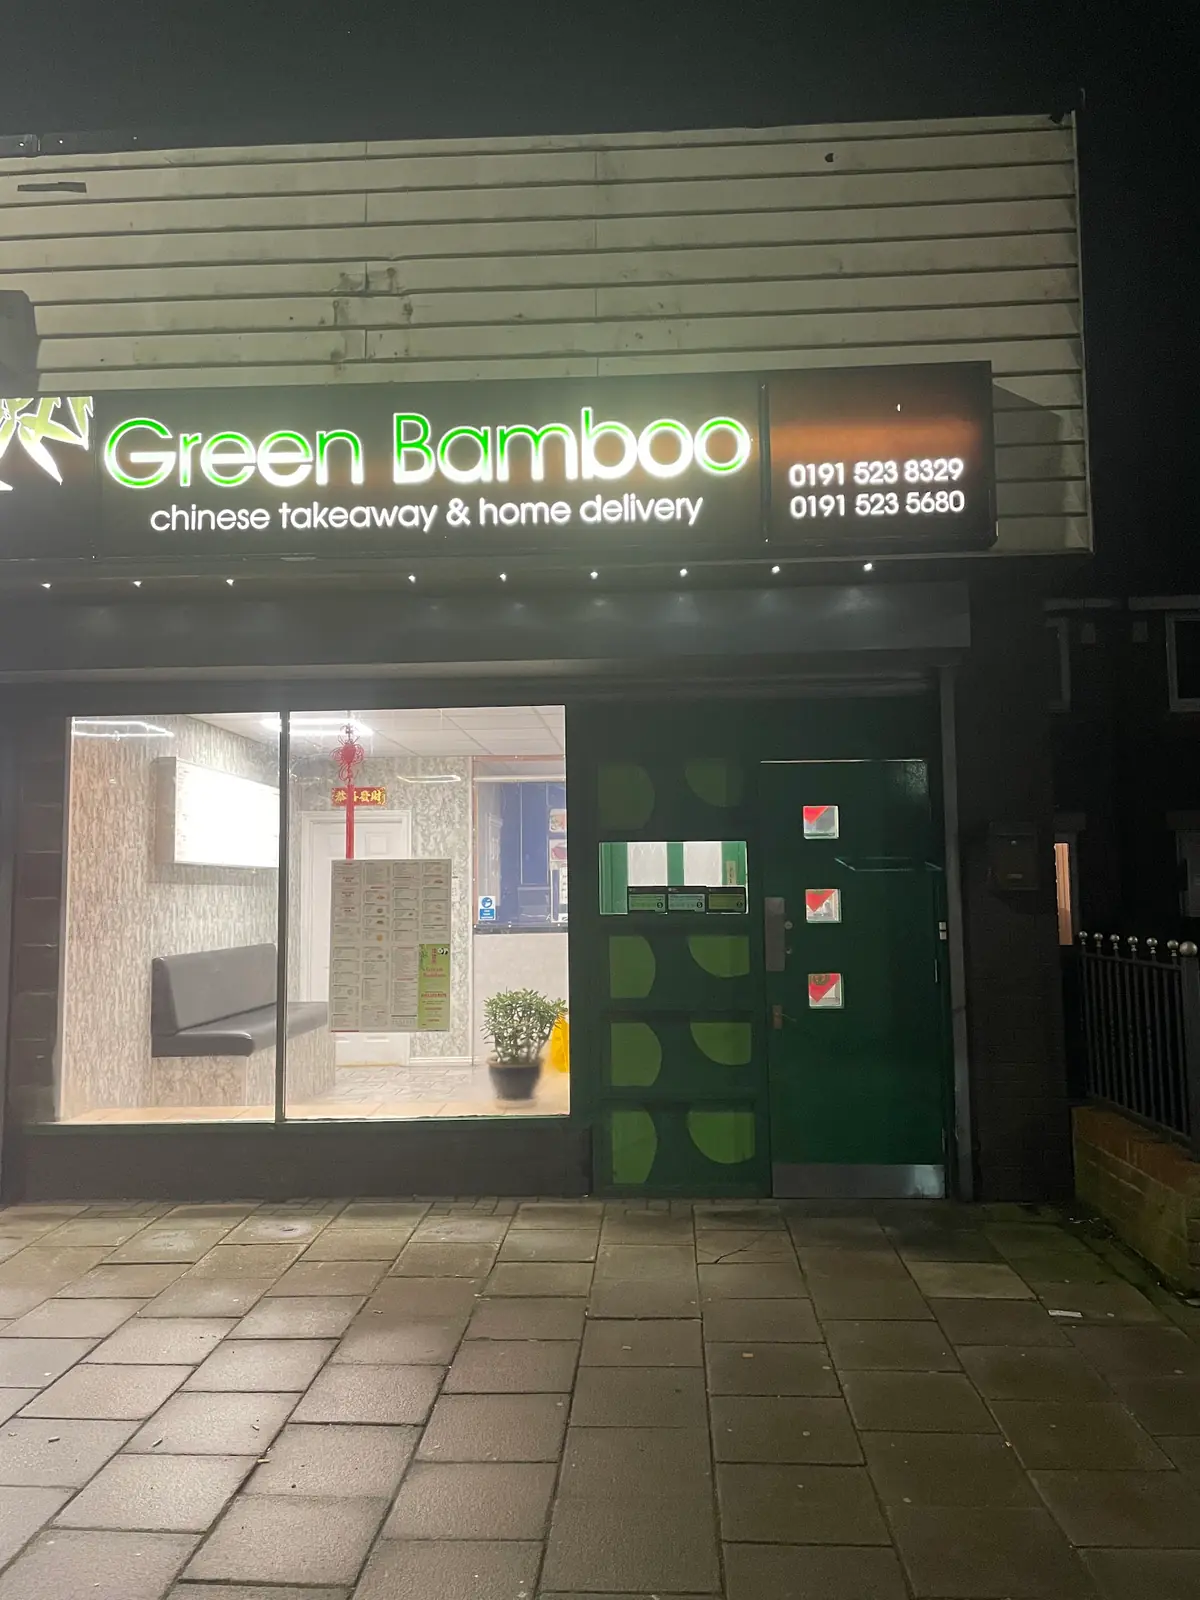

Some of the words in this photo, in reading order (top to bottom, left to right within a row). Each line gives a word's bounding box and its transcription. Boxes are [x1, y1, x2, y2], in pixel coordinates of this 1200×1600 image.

[103, 417, 363, 488] Green
[392, 405, 753, 484] Bamboo
[789, 462, 846, 487] 0191
[853, 460, 898, 484] 523
[905, 458, 965, 482] 8329
[150, 505, 270, 532] chinese
[279, 501, 437, 533] takeaway
[446, 498, 471, 528] &
[478, 496, 572, 527] home
[579, 493, 704, 526] delivery
[790, 494, 847, 519] 0191
[855, 492, 900, 516] 523
[905, 490, 965, 514] 5680
